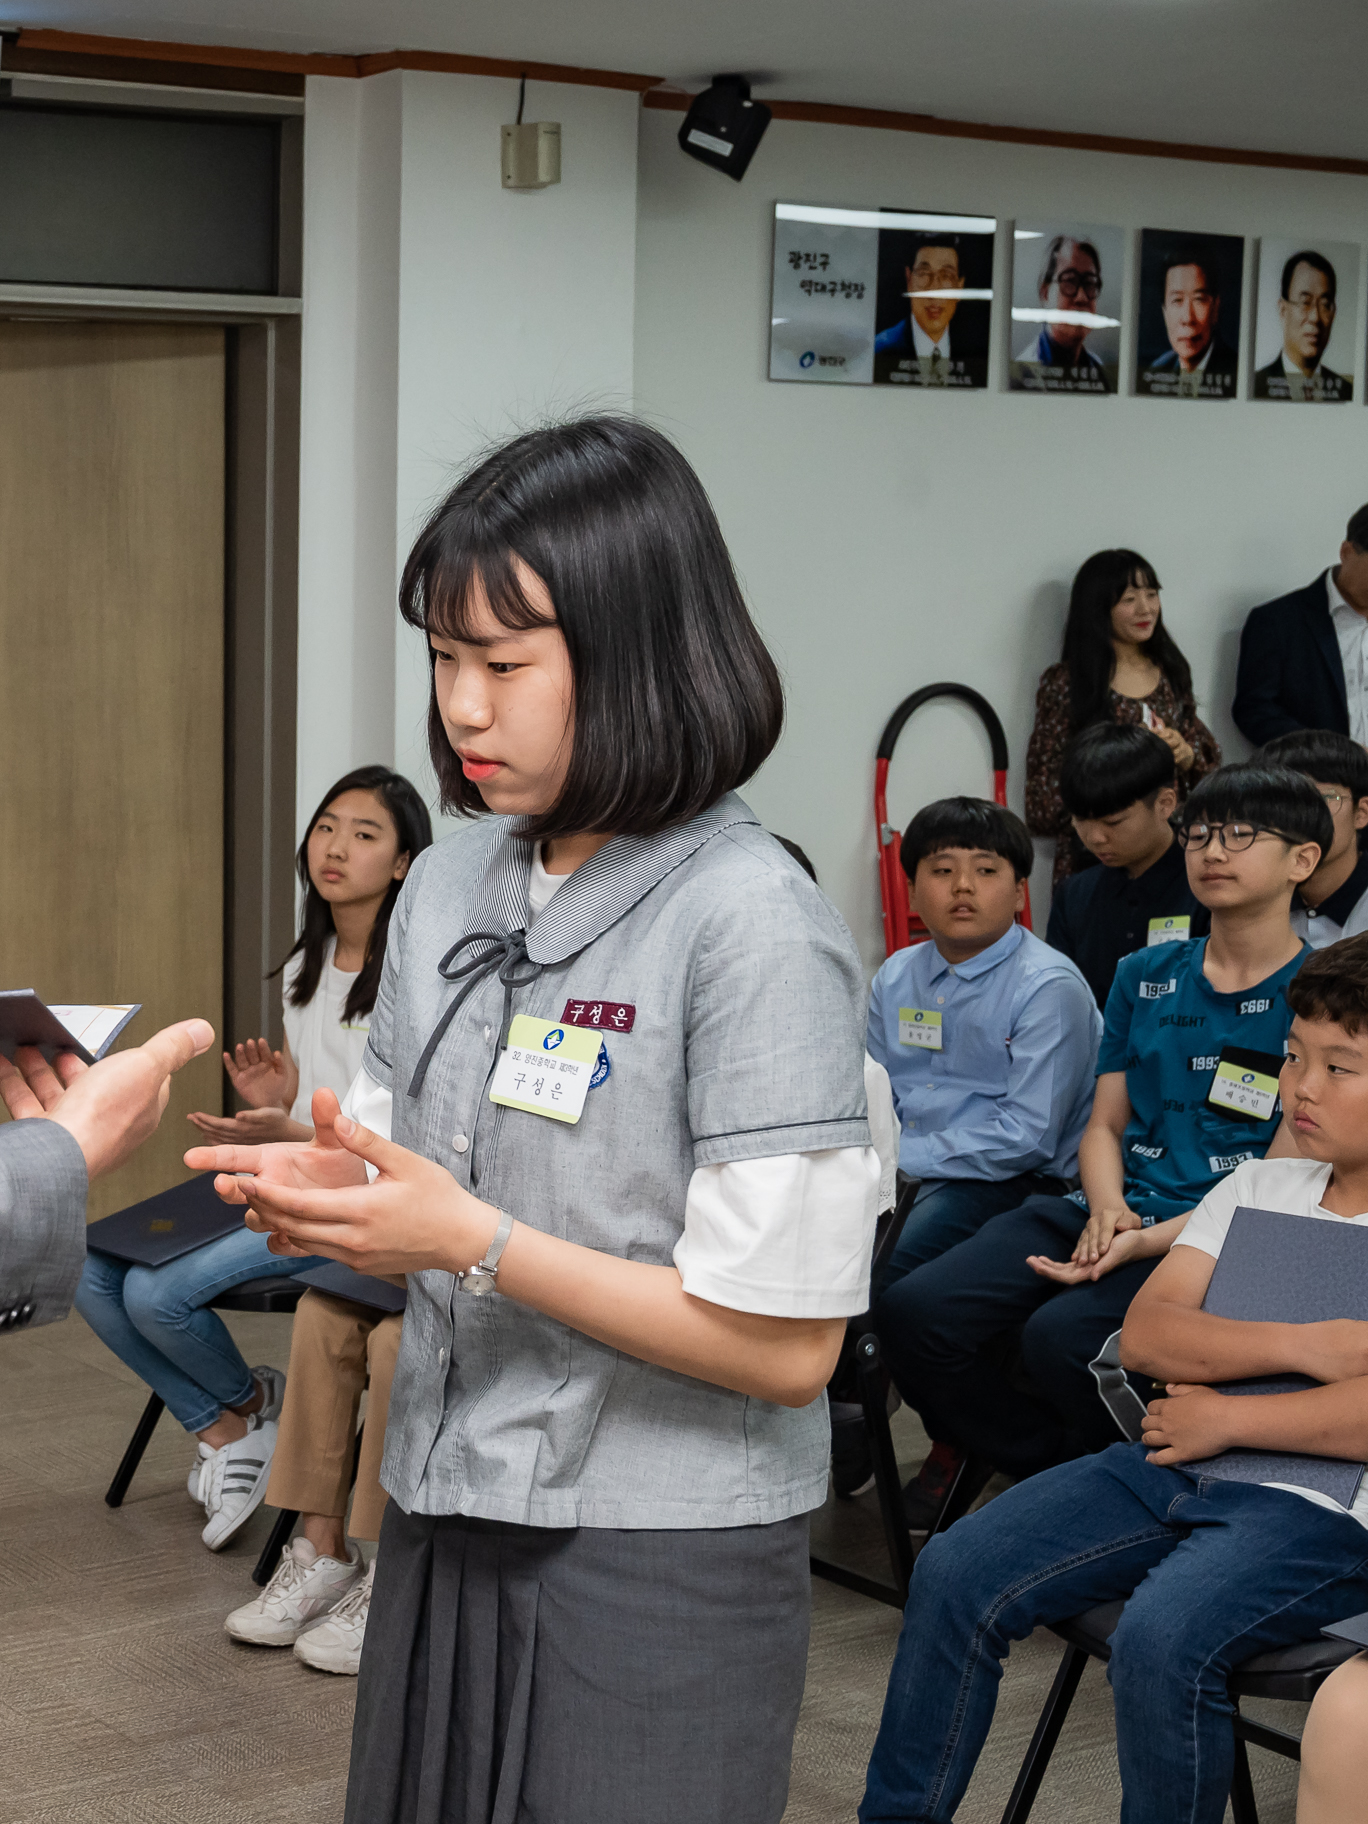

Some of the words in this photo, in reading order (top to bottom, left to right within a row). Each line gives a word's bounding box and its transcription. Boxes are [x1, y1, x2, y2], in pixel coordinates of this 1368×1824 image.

[788, 250, 831, 271] 광진구
[799, 279, 865, 300] 역대구청장
[1158, 1013, 1207, 1029] DELIGHT
